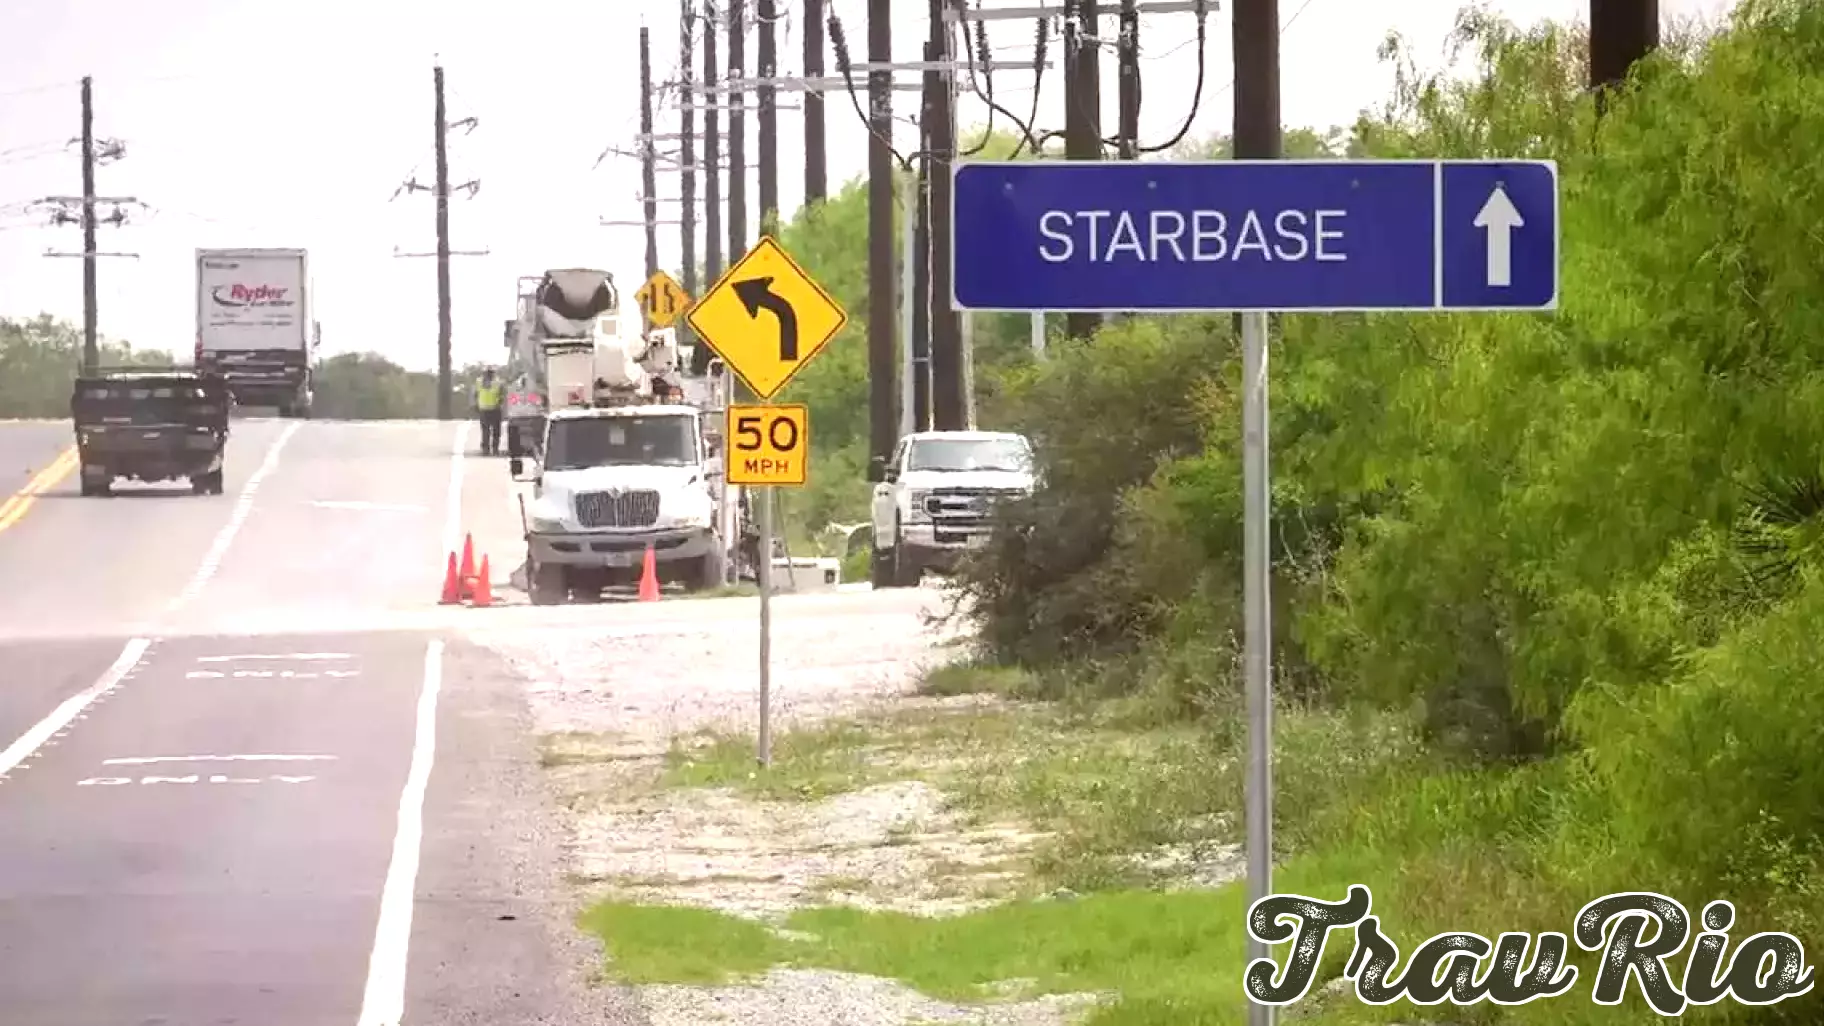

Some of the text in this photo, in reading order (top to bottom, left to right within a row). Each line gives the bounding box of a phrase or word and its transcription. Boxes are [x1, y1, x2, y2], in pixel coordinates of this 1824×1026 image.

[1039, 210, 1347, 262] STARBASE
[736, 416, 798, 452] 50
[744, 458, 789, 475] MPH
